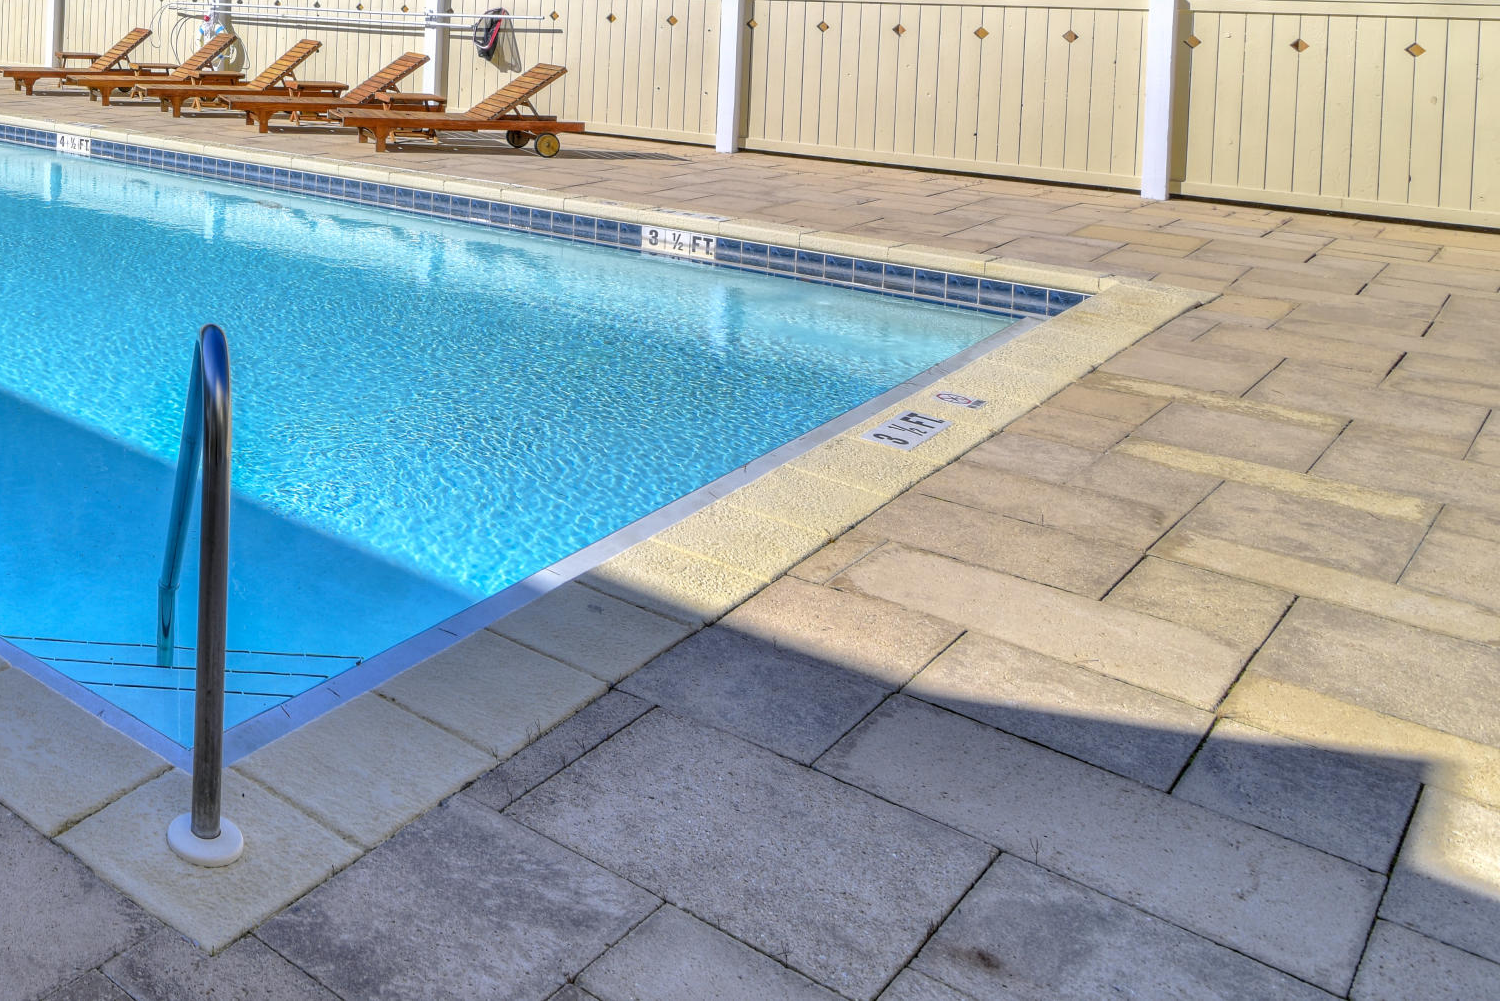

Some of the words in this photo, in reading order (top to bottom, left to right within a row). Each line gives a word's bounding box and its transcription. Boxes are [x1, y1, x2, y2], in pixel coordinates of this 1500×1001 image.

[60, 135, 65, 147] 4
[648, 229, 659, 246] 3
[691, 236, 714, 256] FT.
[873, 433, 909, 445] 3
